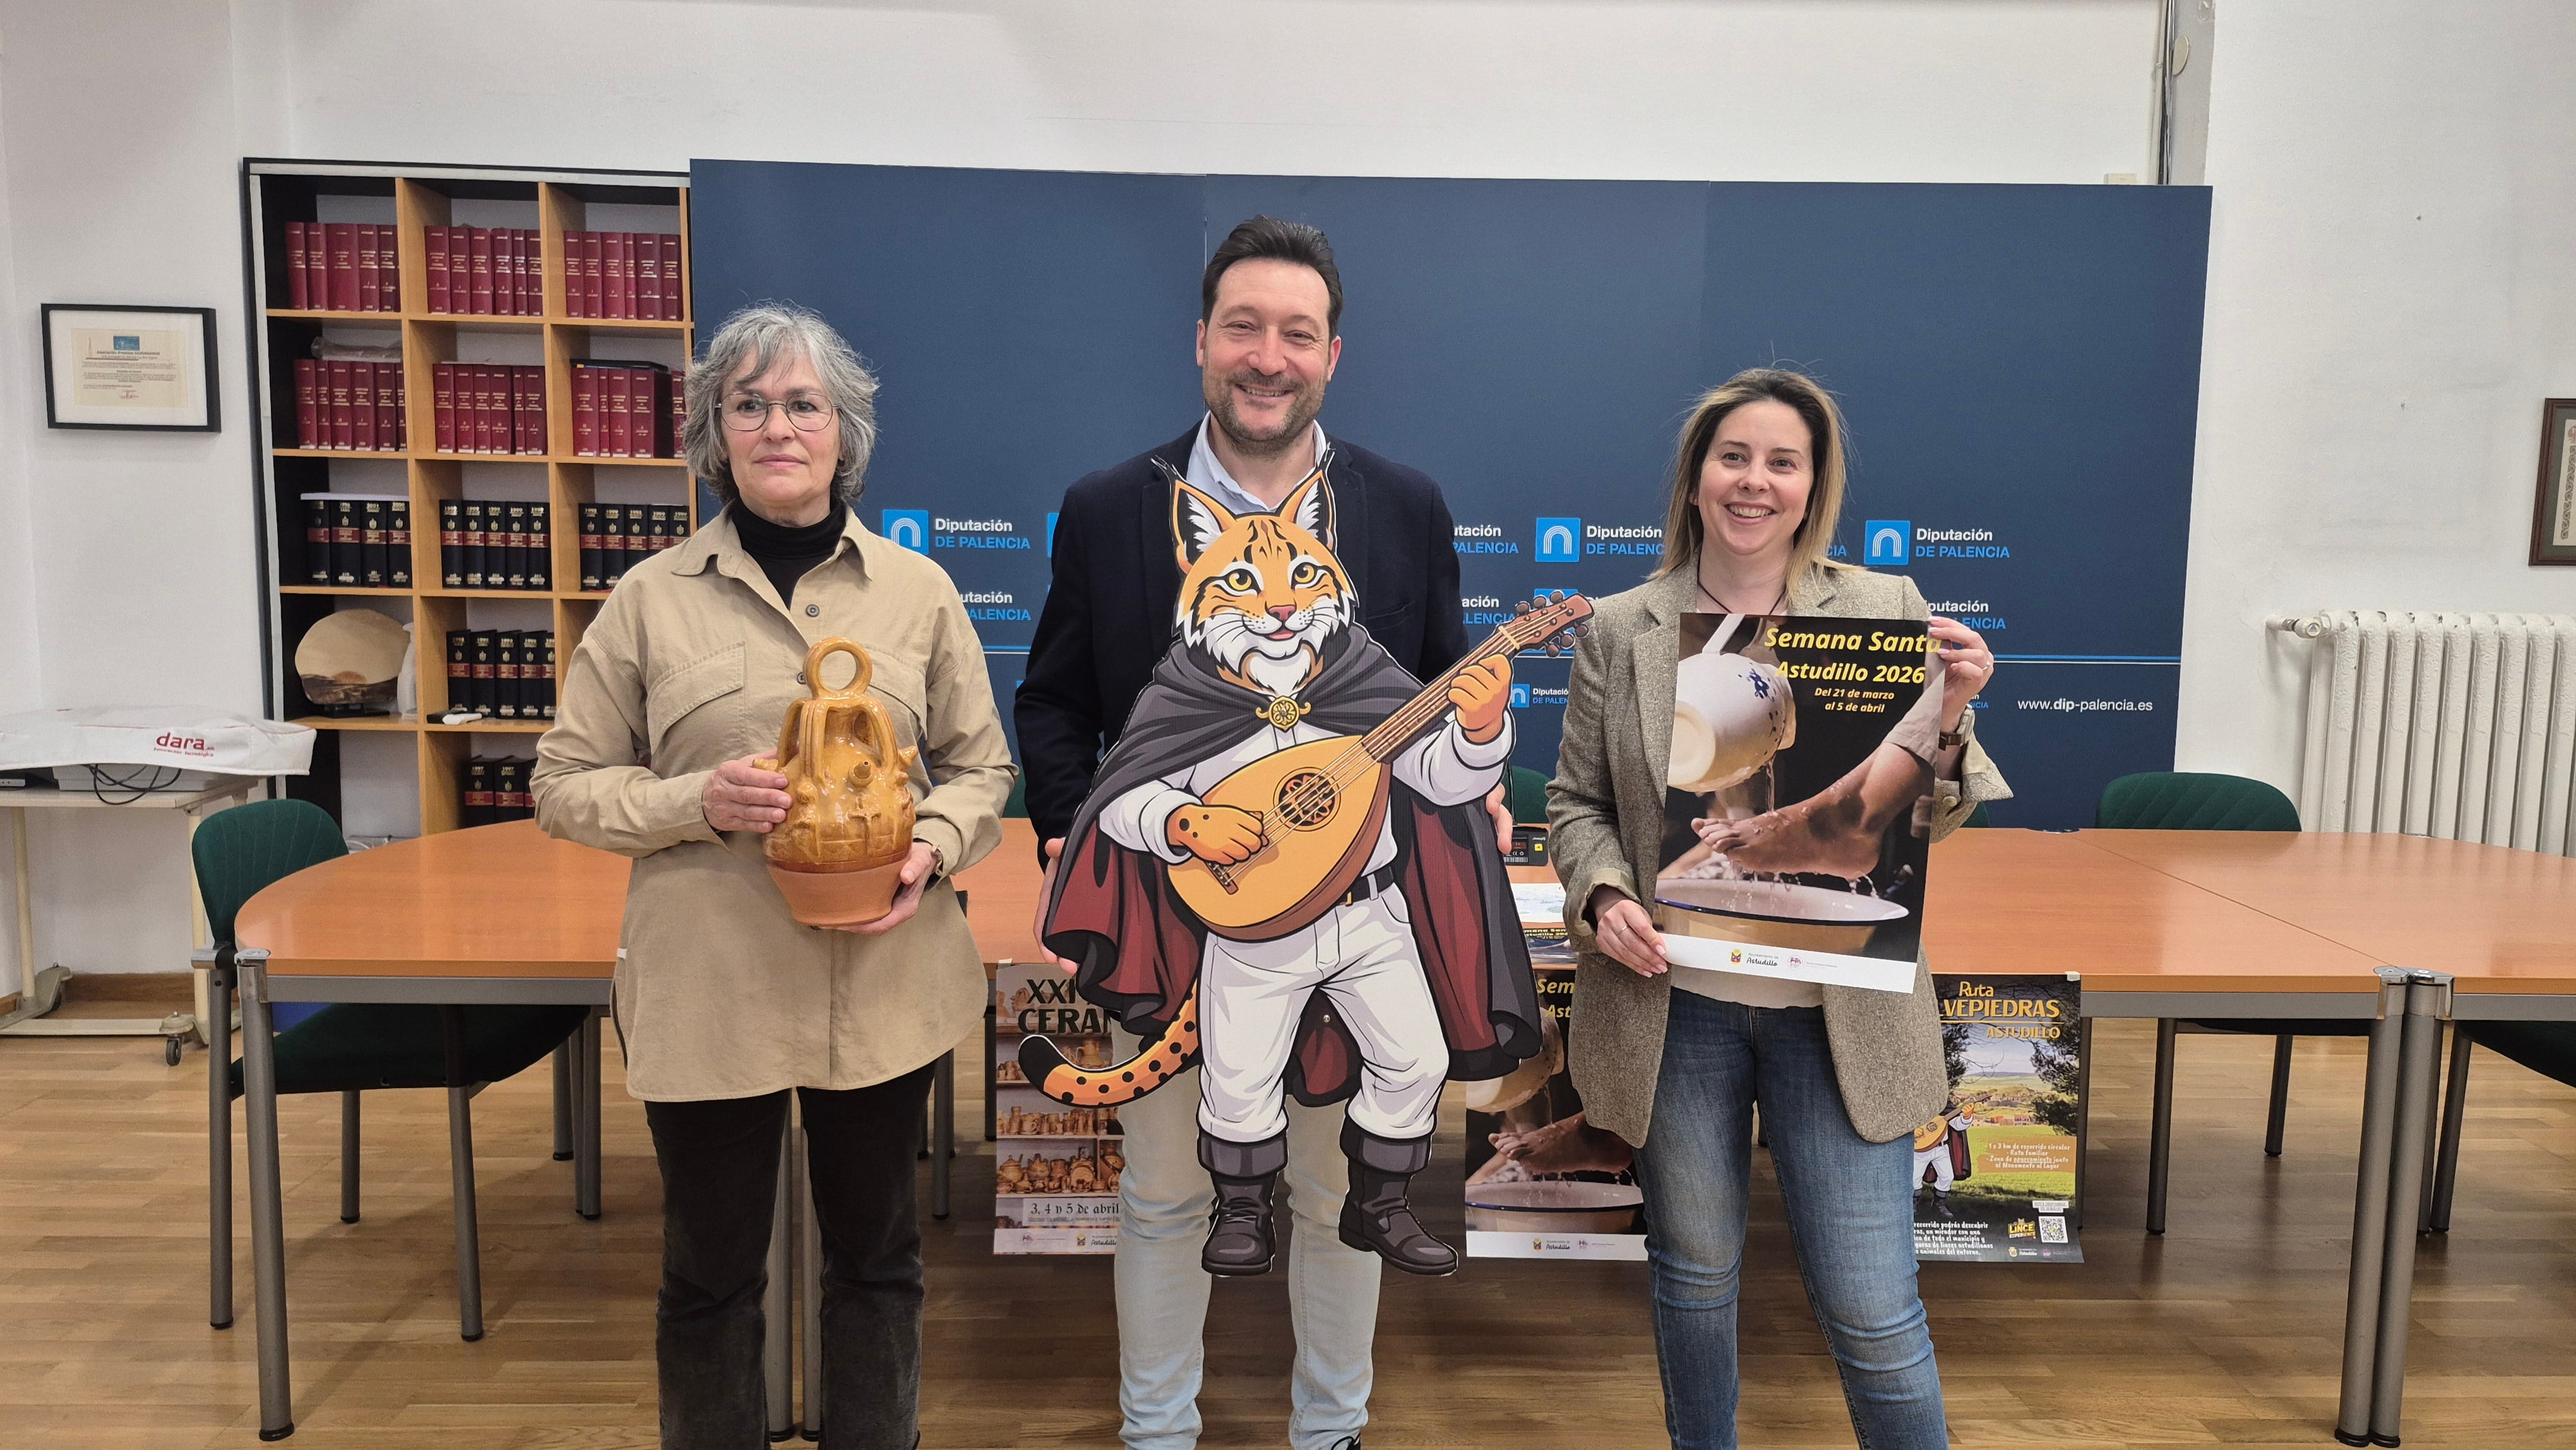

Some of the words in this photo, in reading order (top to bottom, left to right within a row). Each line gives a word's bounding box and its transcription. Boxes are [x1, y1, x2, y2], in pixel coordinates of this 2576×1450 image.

[935, 518, 1012, 533] Diputación
[1587, 525, 1662, 540] Diputación
[1916, 528, 1993, 543] Diputación
[935, 536, 955, 547] DE
[960, 536, 1030, 549] PALENCIA
[1586, 543, 1605, 554] DE
[1610, 543, 1664, 555] PALENC
[1915, 545, 1935, 558] DE
[1939, 546, 2010, 558] PALENCIA
[960, 591, 1012, 603] utación
[1462, 596, 1499, 608] ación
[1927, 600, 1989, 612] putación
[969, 608, 1032, 621] ALENCIA
[1962, 617, 2006, 629] ENCIA
[1764, 628, 1862, 650] Semana
[1868, 632, 1942, 653] Santa
[1774, 661, 1868, 682] Astudillo
[1873, 665, 1927, 684] 2026
[1533, 688, 1569, 696] Diputació
[1814, 688, 1832, 697] Del
[1833, 688, 1846, 697] 21
[1847, 689, 1861, 698] de
[1862, 691, 1895, 700] marzo
[1824, 701, 1835, 710] al
[1837, 702, 1844, 711] 5
[1845, 702, 1859, 711] de
[1861, 703, 1885, 713] abril
[2018, 698, 2153, 713] www.dip-palencia.es
[156, 731, 204, 751] dara
[1746, 957, 1777, 966] Astudillo
[1027, 979, 1076, 1004] XXI
[1537, 978, 1575, 994] Sem
[1959, 981, 1994, 997] Ruta
[1940, 999, 2060, 1018] VEPIEDRAS
[1987, 1026, 2061, 1039] ASTUDILLO
[1031, 1203, 1040, 1215] 3,
[1045, 1203, 1051, 1214] 4
[1066, 1203, 1074, 1214] 5
[1077, 1204, 1089, 1214] de
[1093, 1203, 1119, 1214] abril
